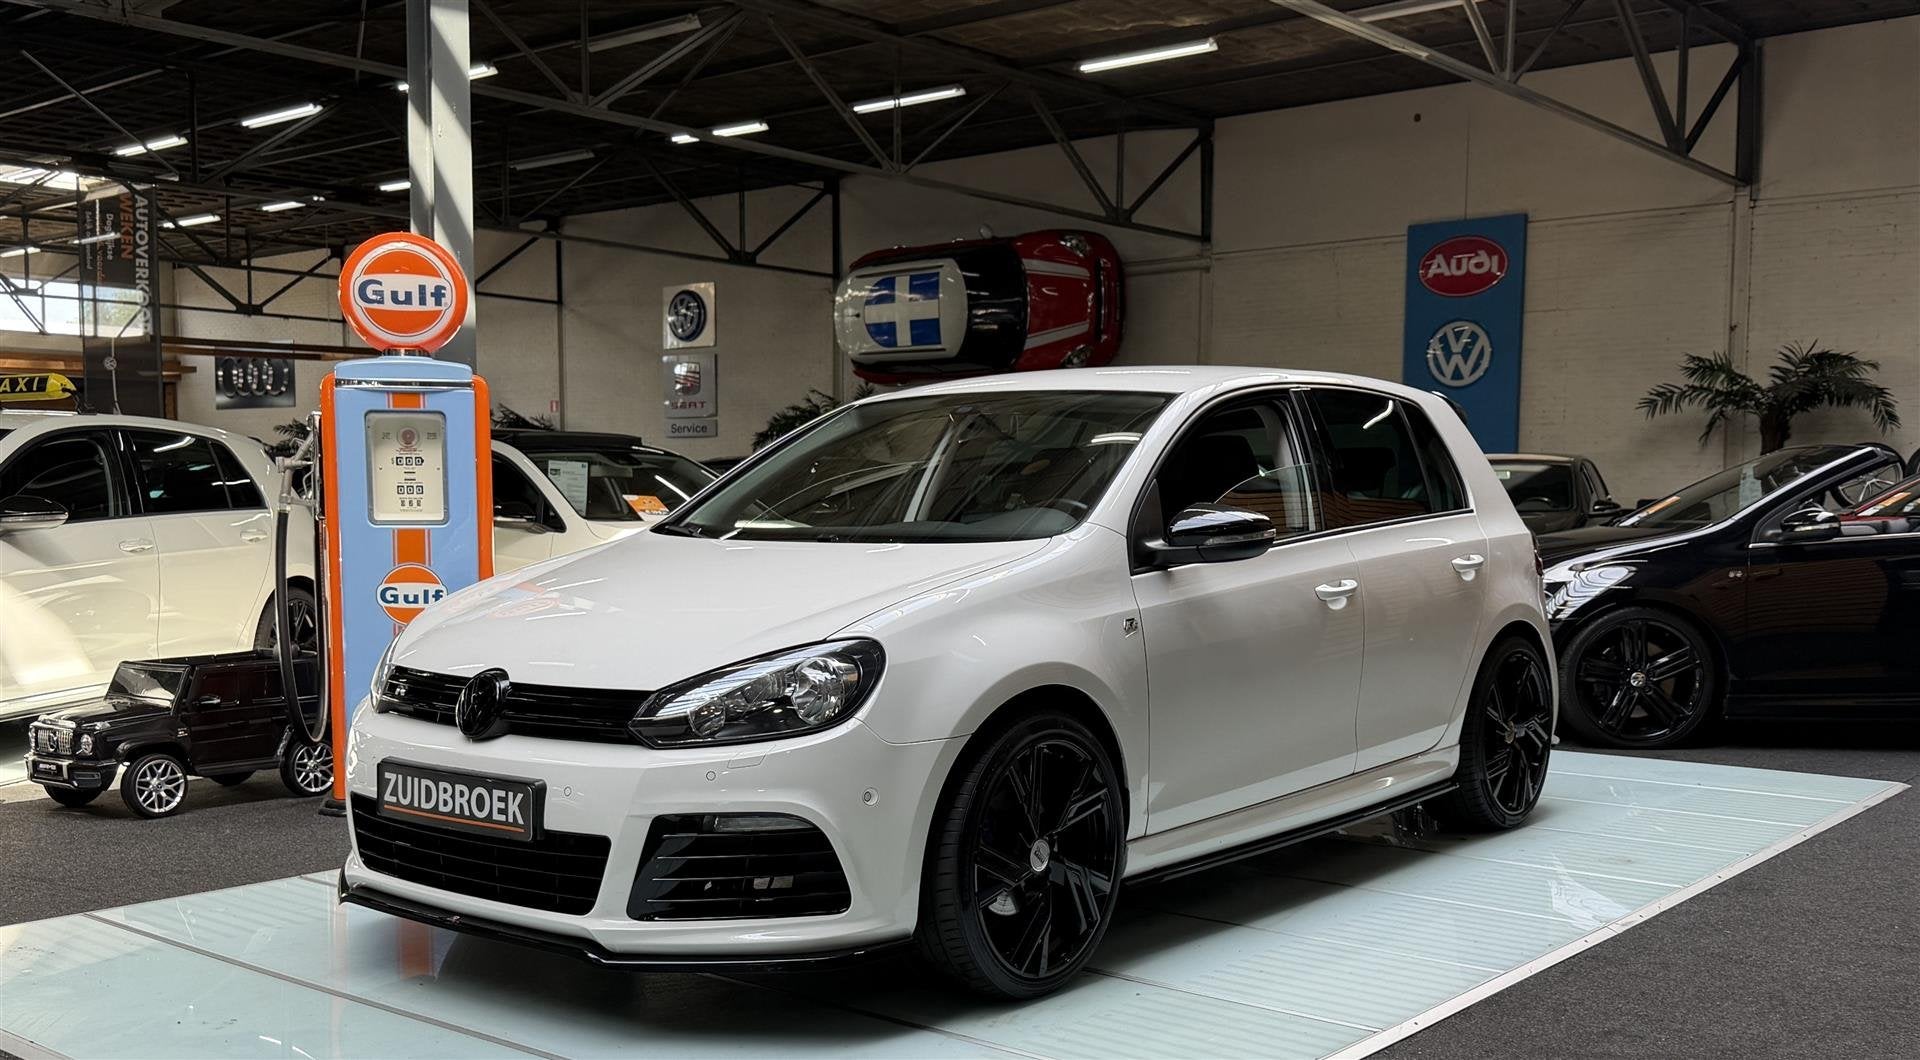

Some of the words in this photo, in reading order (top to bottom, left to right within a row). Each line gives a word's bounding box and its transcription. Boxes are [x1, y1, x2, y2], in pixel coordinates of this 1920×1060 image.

[120, 193, 134, 260] WEKEN
[358, 279, 446, 306] Gulf
[671, 401, 706, 409] SEAT
[671, 423, 708, 434] Service
[380, 587, 444, 604] Gulf
[384, 771, 524, 825] ZUIDBROEK
